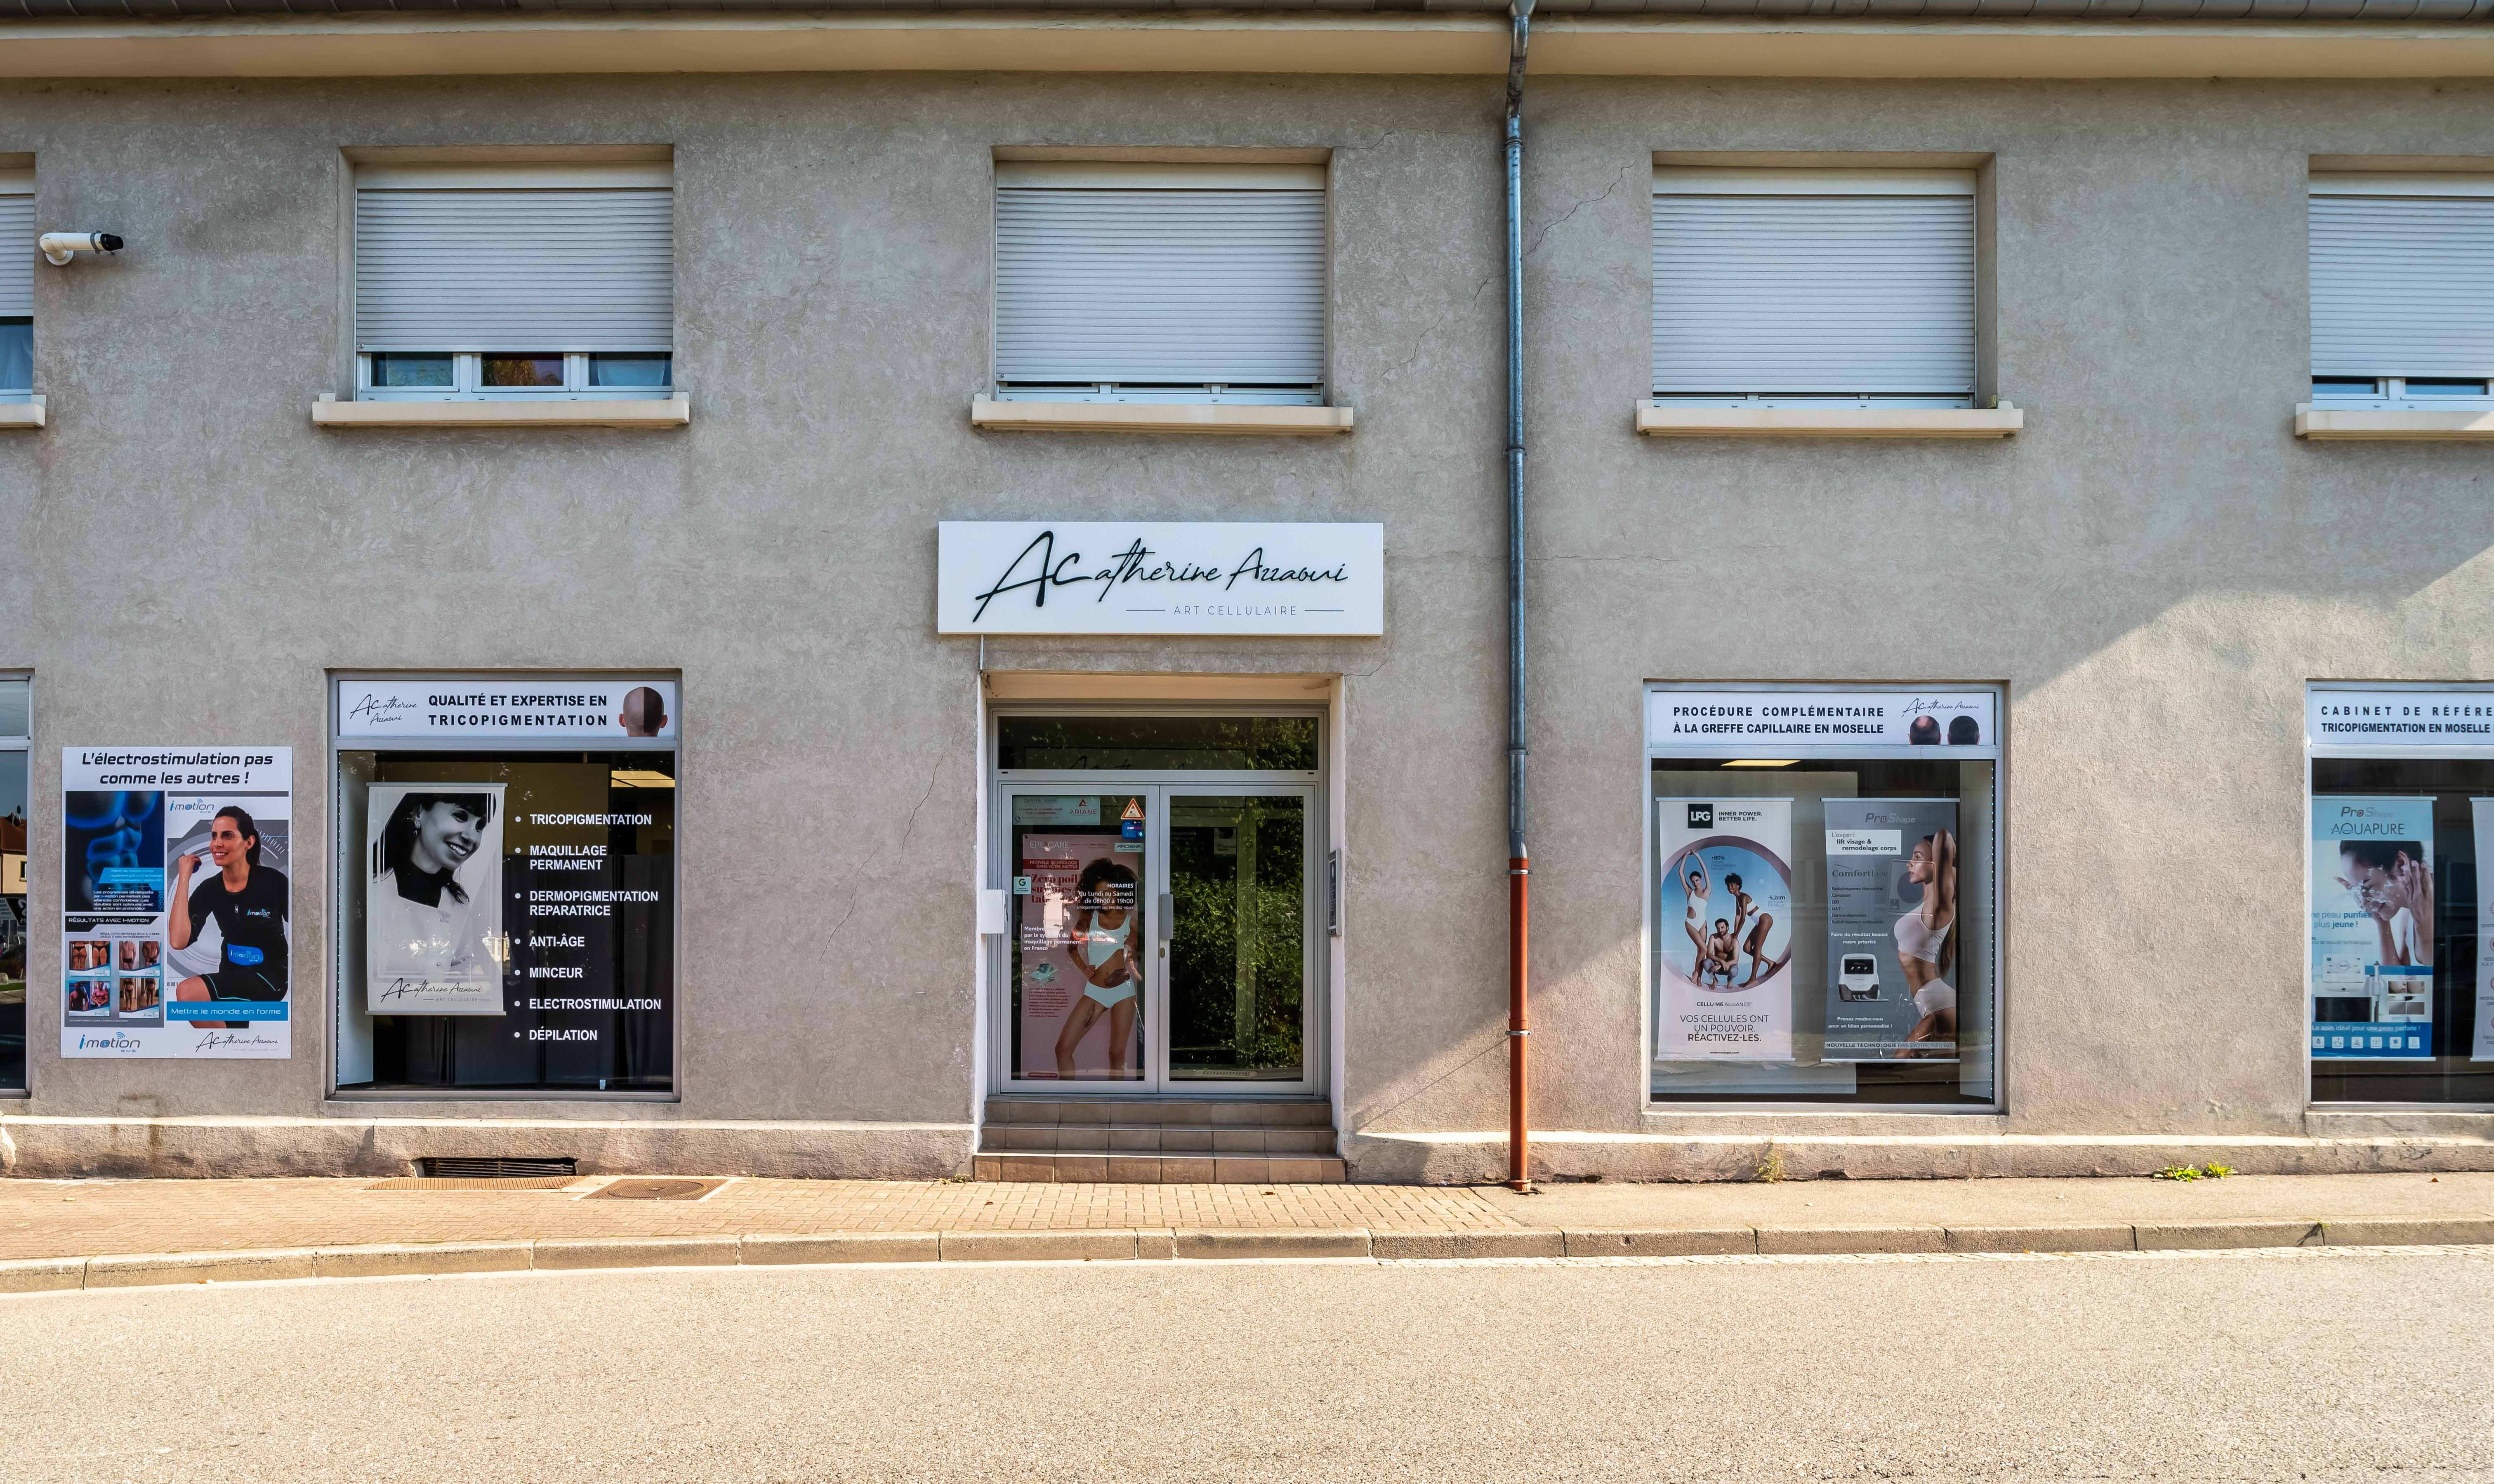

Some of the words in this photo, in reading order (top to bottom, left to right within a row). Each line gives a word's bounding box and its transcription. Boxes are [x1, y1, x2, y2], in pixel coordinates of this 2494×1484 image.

[1174, 606, 1200, 615] ART
[1208, 606, 1297, 615] CELLULAIRE
[429, 693, 486, 706] QUALITÉ
[490, 695, 507, 706] ET
[512, 695, 579, 706] EXPERTISE
[589, 695, 607, 706] EN
[1674, 705, 1753, 716] PROCÉDURE
[1762, 705, 1883, 717] COMPLÉMENTAIRE
[2322, 706, 2391, 716] CABINET
[2404, 707, 2420, 716] DE
[429, 715, 607, 726] TRICOPIGMENTATION
[1674, 721, 1681, 733] À
[1684, 724, 1698, 733] LA
[1702, 724, 1743, 733] GREFFE
[1747, 724, 1811, 733] CAPILLAIRE
[1815, 724, 1829, 733] EN
[1833, 724, 1883, 733] MOSELLE
[2322, 723, 2426, 732] TRICOPIGMENTATION
[2429, 723, 2442, 733] EN
[2445, 724, 2490, 733] MOSELLE
[83, 753, 240, 765] L'électrostimulation
[244, 755, 273, 767] pas
[100, 775, 156, 784] comme
[161, 772, 183, 784] les
[187, 773, 240, 784] autres
[245, 772, 249, 784] !
[530, 814, 651, 824] TRICOPIGMENTATION
[1691, 811, 1711, 821] LPG
[2331, 823, 2404, 835] AQUAPURE
[530, 846, 607, 856] MAQUILLAGE
[530, 860, 603, 870] PERMANENT
[1058, 874, 1077, 886] poil
[530, 891, 658, 901] DERMOPIGMENTATION
[530, 905, 611, 916] REPARATRICE
[2332, 921, 2354, 929] jeune
[529, 934, 585, 947] ANTI-ÂGE
[530, 968, 583, 978] MINCEUR
[530, 999, 661, 1009] ELECTROSTIMULATION
[529, 1026, 597, 1040] DÉPILATION
[1688, 1032, 1761, 1041] RÉACTIVEZ-LES.
